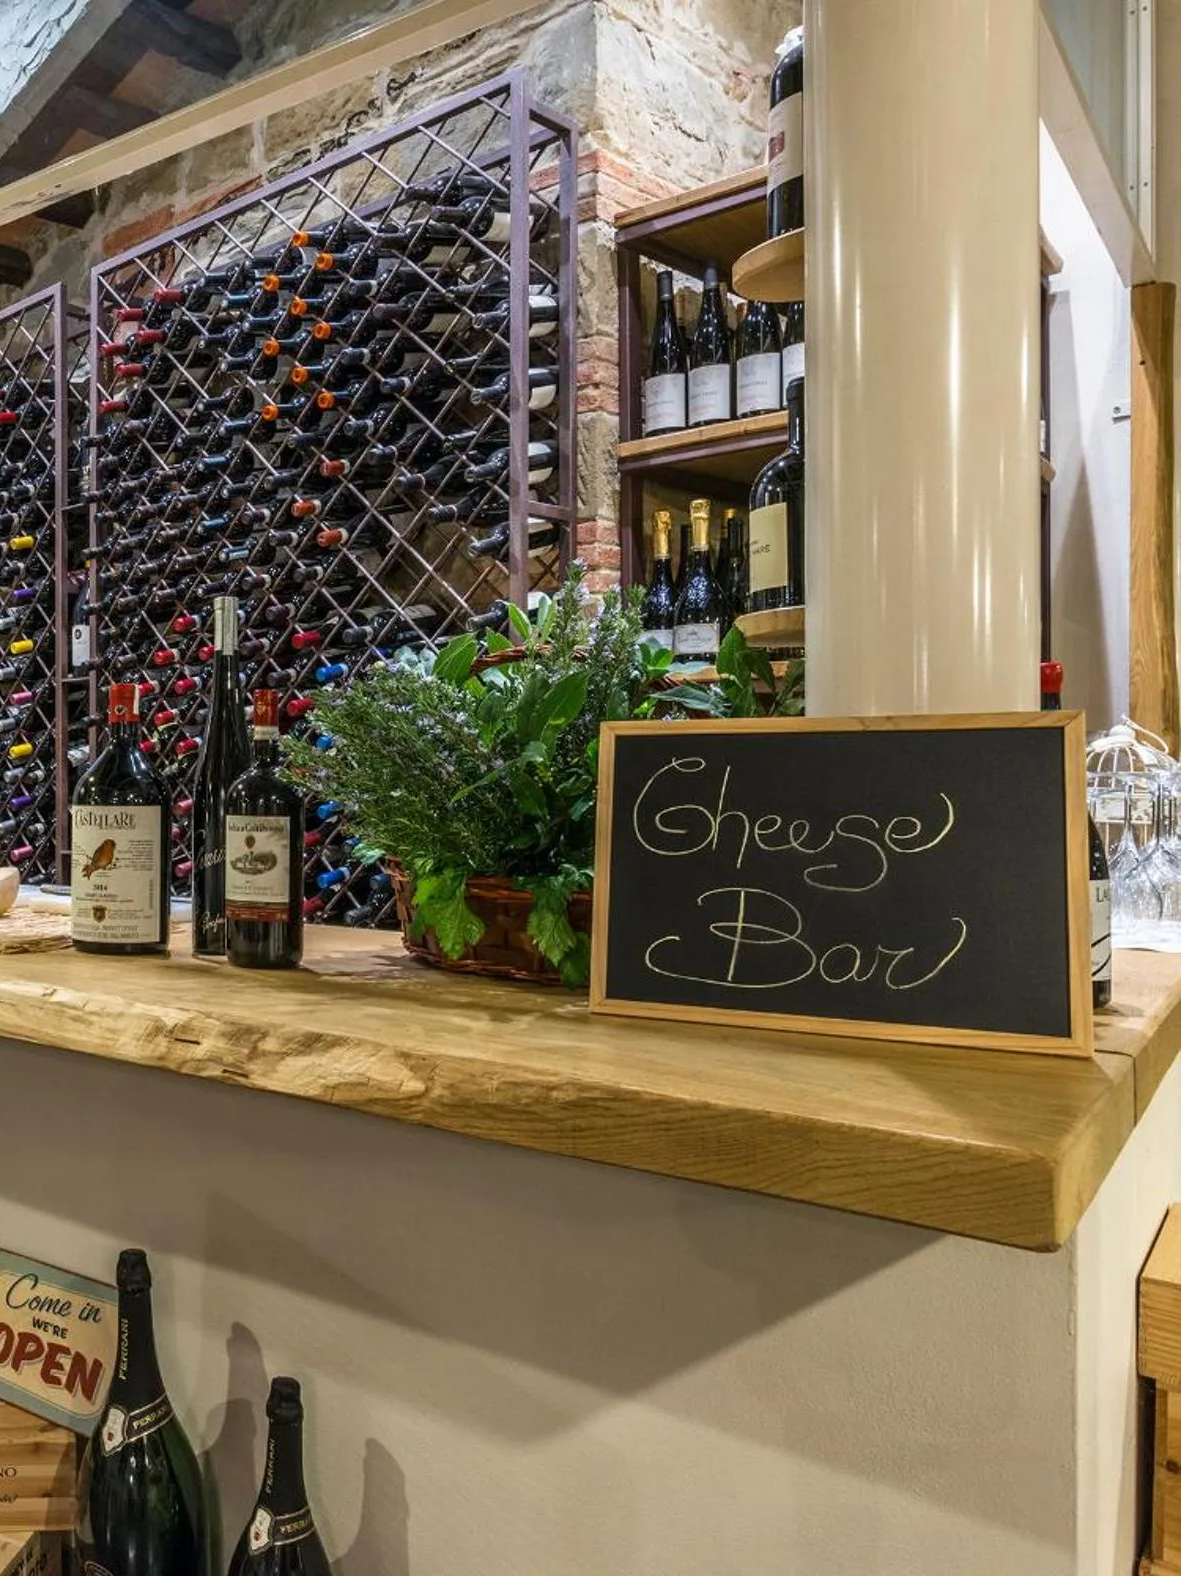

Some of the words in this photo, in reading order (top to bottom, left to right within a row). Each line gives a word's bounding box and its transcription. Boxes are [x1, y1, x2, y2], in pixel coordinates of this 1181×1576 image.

[633, 756, 957, 892] Cheese
[645, 886, 967, 990] Bar
[5, 1273, 72, 1318] Come
[78, 1301, 103, 1324] in
[32, 1316, 69, 1339] WE'RE
